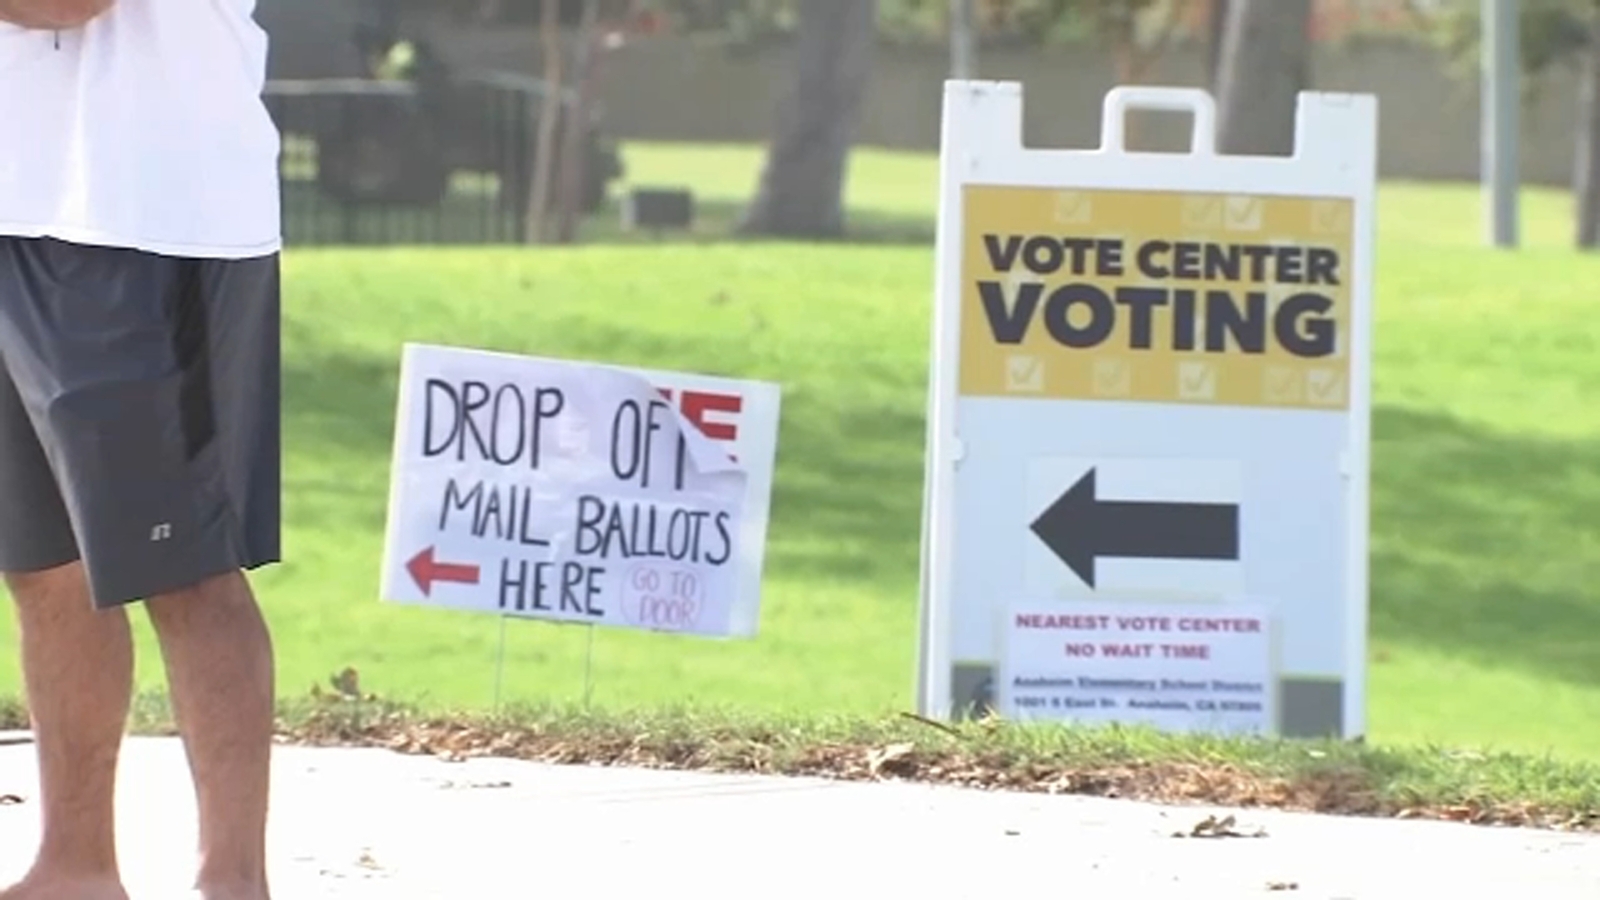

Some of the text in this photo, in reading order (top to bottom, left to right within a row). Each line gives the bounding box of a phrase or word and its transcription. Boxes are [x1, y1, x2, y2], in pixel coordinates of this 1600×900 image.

[982, 233, 1341, 286] VOTE CENTER
[976, 280, 1337, 359] VOTING
[422, 378, 565, 470] DROP
[439, 478, 732, 566] MAIL BALLOTS
[499, 558, 606, 617] HERE
[631, 566, 697, 599] GO TO
[637, 594, 698, 626] DOOR
[1015, 613, 1262, 633] NEAREST VOTE CENTER
[1065, 643, 1211, 660] NO WAIT TIME
